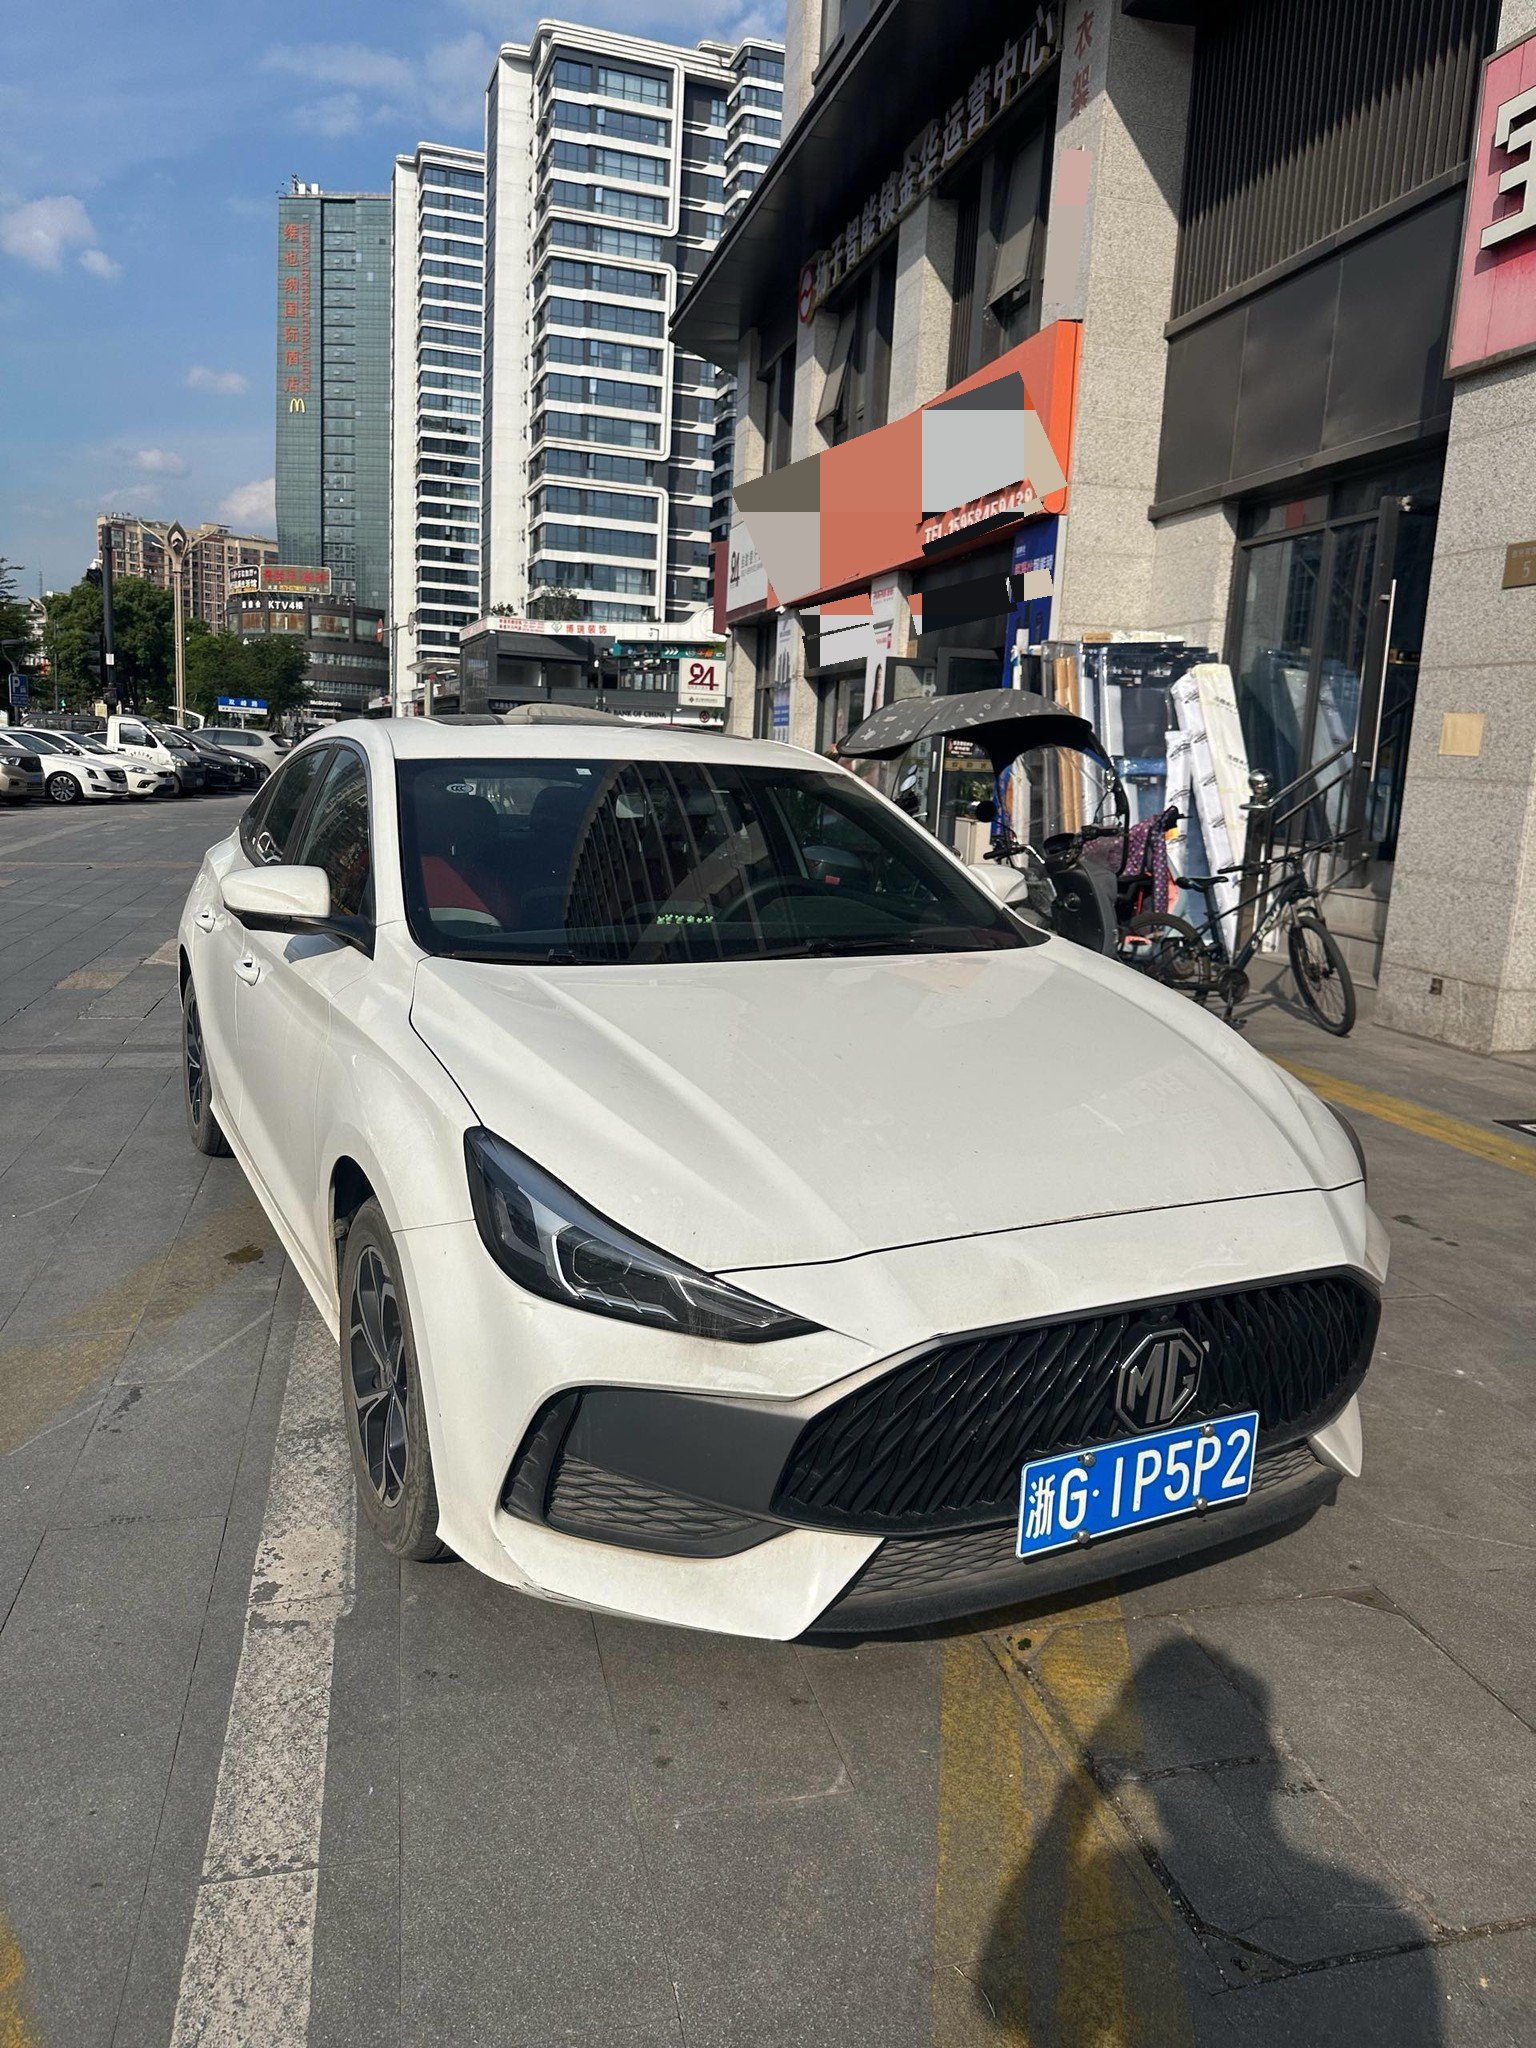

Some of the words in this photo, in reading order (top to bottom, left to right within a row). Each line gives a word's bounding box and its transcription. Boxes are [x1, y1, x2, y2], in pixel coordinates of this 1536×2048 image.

[283, 223, 299, 392] 维也纳国际酒店
[12, 677, 20, 692] P
[688, 663, 719, 690] 24
[1126, 1338, 1198, 1424] MG
